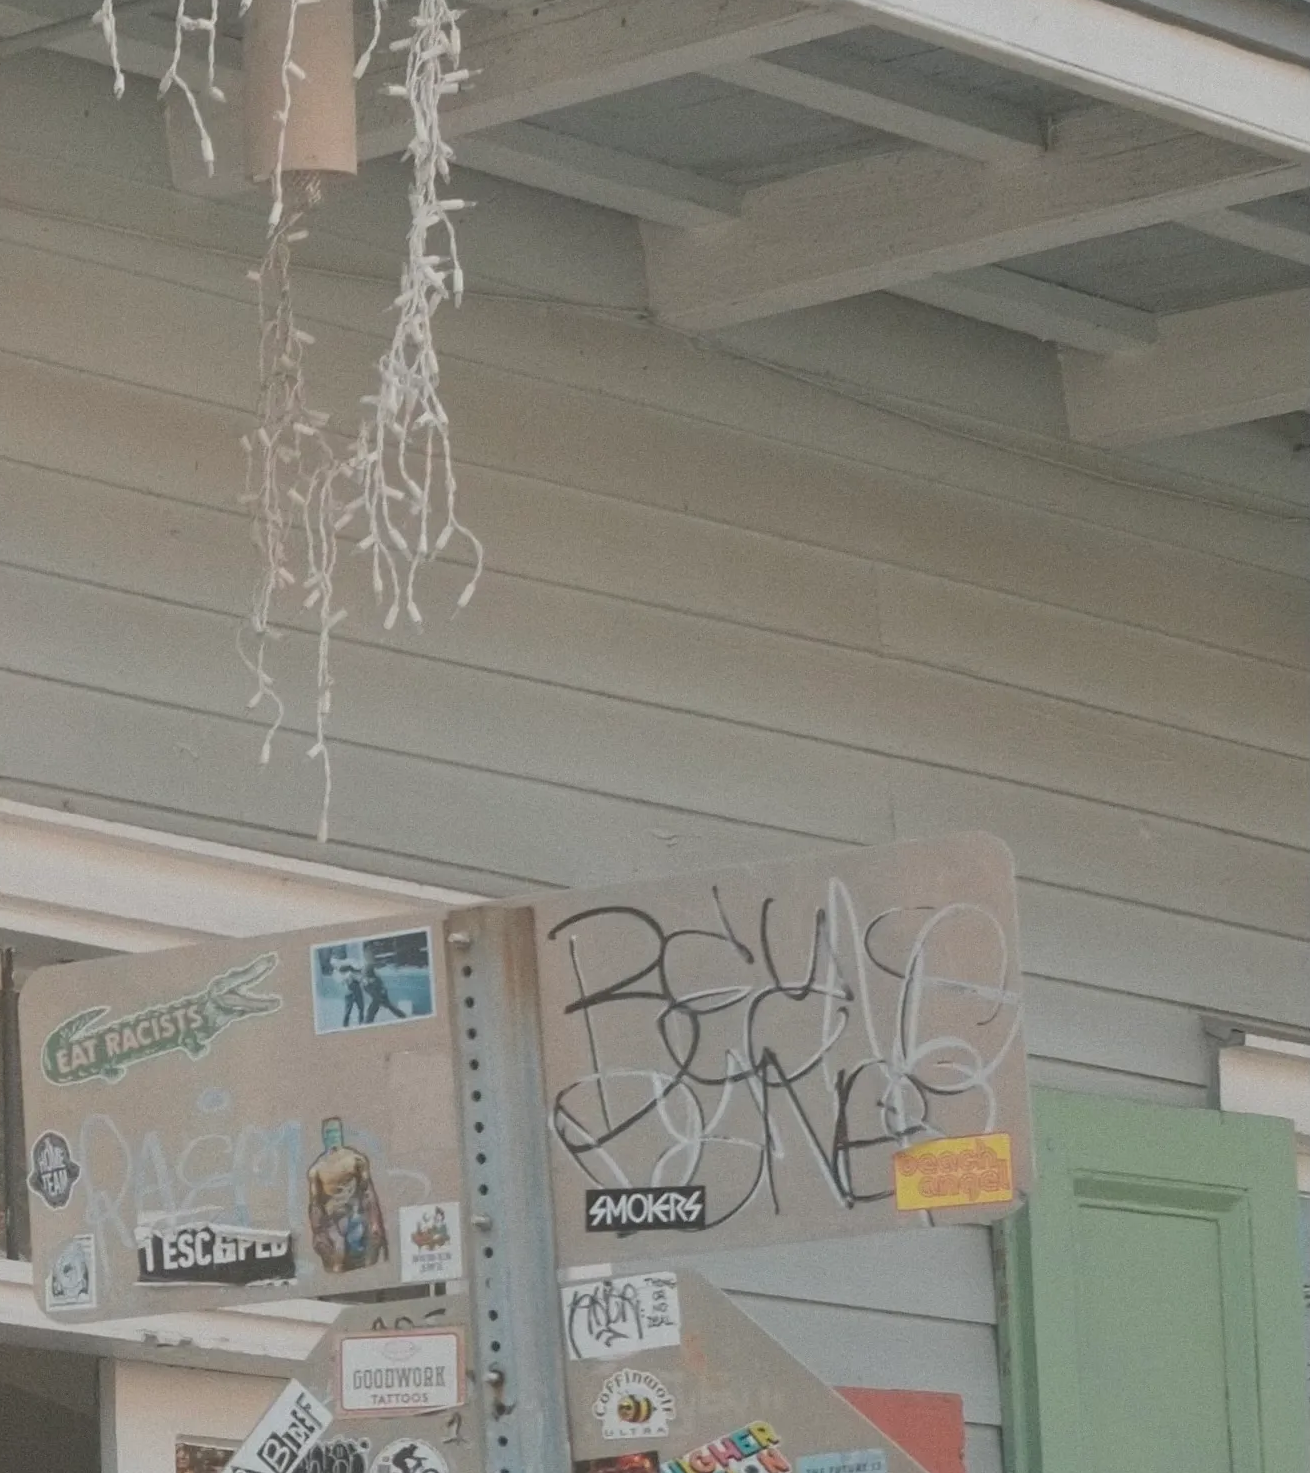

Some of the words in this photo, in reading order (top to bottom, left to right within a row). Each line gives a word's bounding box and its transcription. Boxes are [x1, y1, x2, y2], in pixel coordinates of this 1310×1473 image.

[55, 1037, 99, 1074] EAT
[104, 1004, 204, 1058] RACISTS
[588, 1190, 704, 1229] SMOKERS
[353, 1365, 447, 1390] GOODWORK
[371, 1393, 429, 1406] TATTOOS
